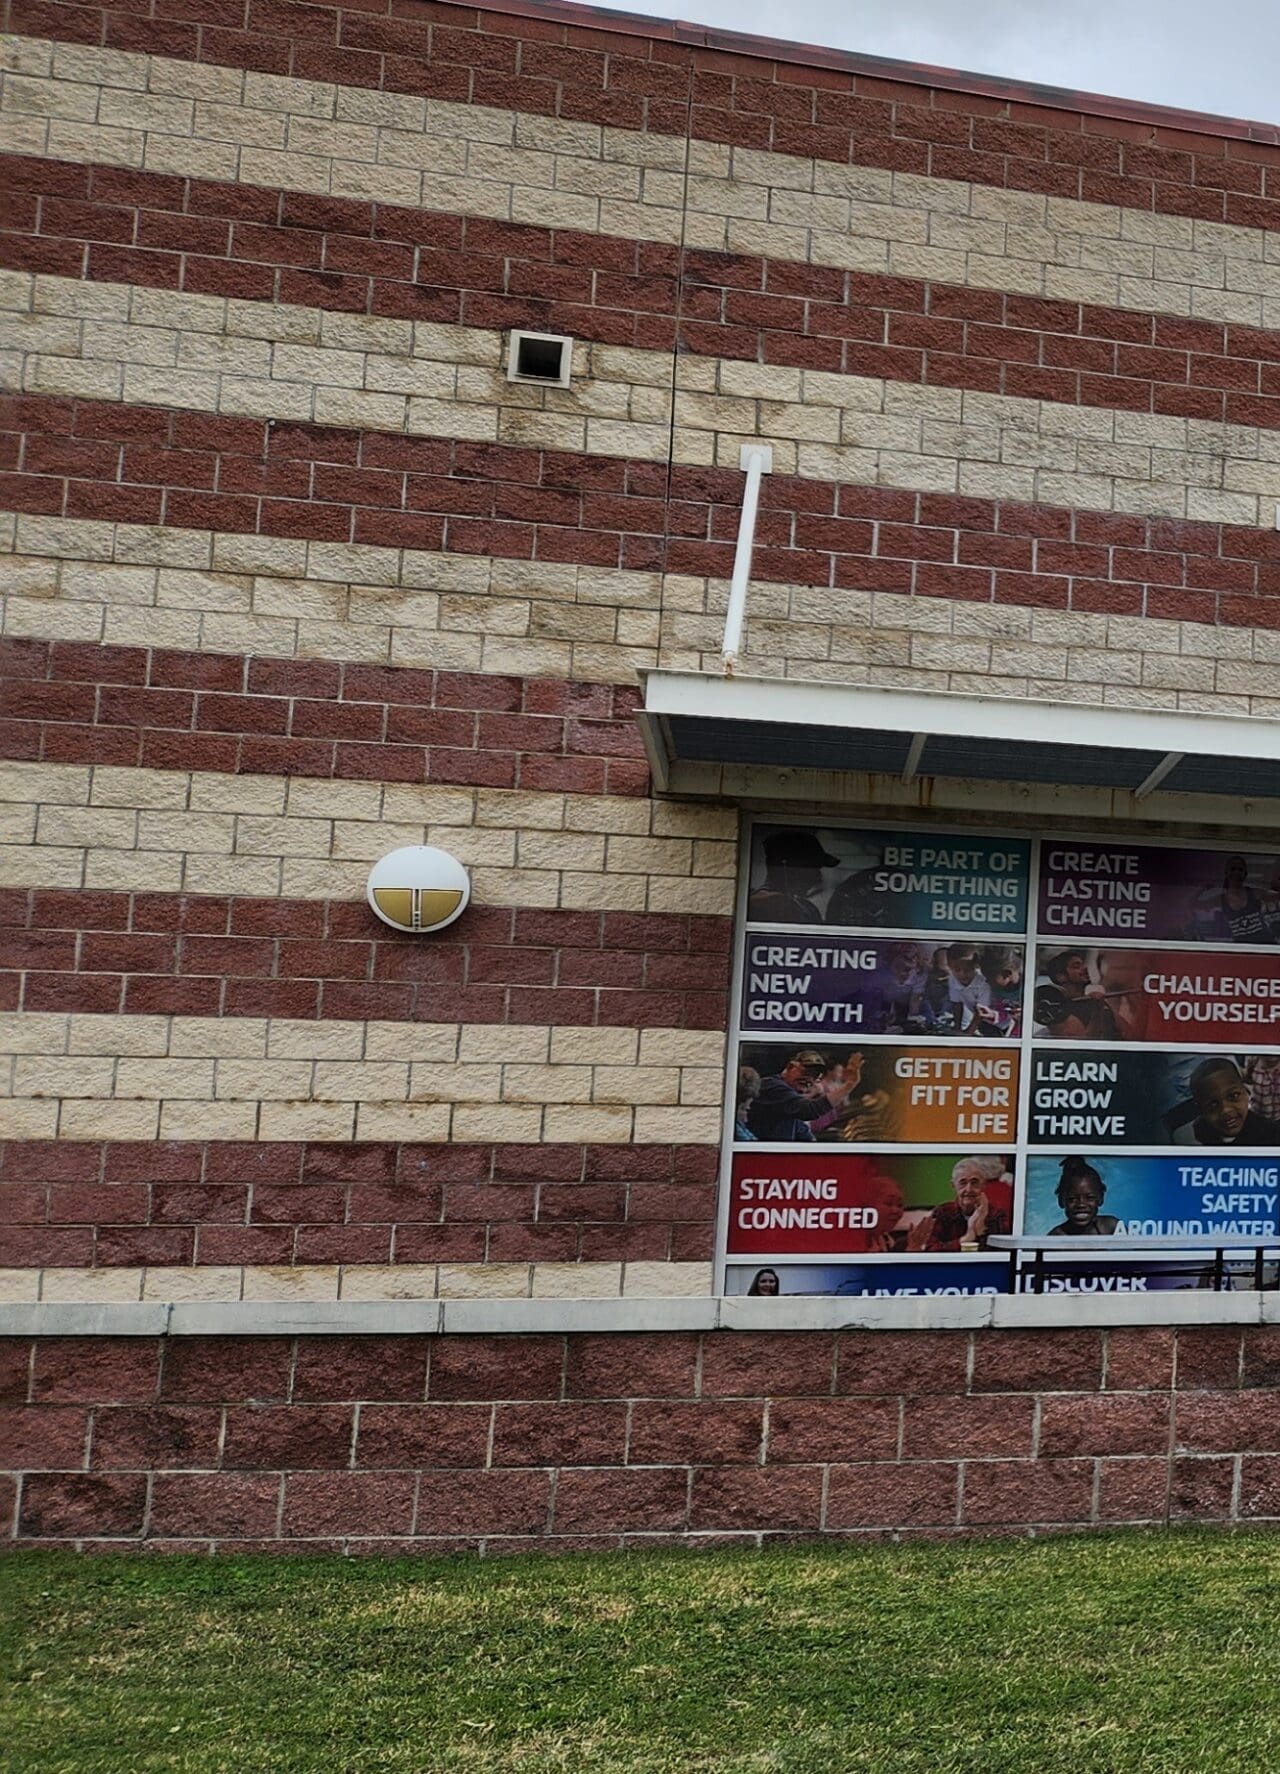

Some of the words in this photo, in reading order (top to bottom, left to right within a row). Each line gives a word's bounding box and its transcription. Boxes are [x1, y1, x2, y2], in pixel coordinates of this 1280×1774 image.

[884, 847, 914, 867] BE
[920, 849, 984, 870] PART
[989, 853, 1021, 872] OF
[1048, 851, 1139, 874] CREATE
[873, 872, 1019, 897] SOMETHING
[1048, 878, 1150, 902] LASTING
[931, 901, 1017, 923] BIGGER
[1046, 905, 1147, 928] CHANGE
[751, 945, 877, 970] CREATING
[750, 973, 811, 995] NEW
[747, 1000, 863, 1023] GROWTH
[895, 1057, 1011, 1080] GETTING
[1036, 1061, 1118, 1082] LEARN
[911, 1085, 952, 1106] FIT
[957, 1085, 1009, 1107] FOR
[1034, 1088, 1112, 1109] GROW
[957, 1113, 1009, 1134] LIFE
[1033, 1115, 1125, 1137] THRIVE
[1178, 1167, 1278, 1187] TEACHING
[739, 1178, 837, 1200] STAYING
[1201, 1193, 1278, 1213] SAFETY
[737, 1206, 879, 1230] CONNECTED
[1113, 1220, 1203, 1236] AROUND
[1207, 1220, 1275, 1237] WATER
